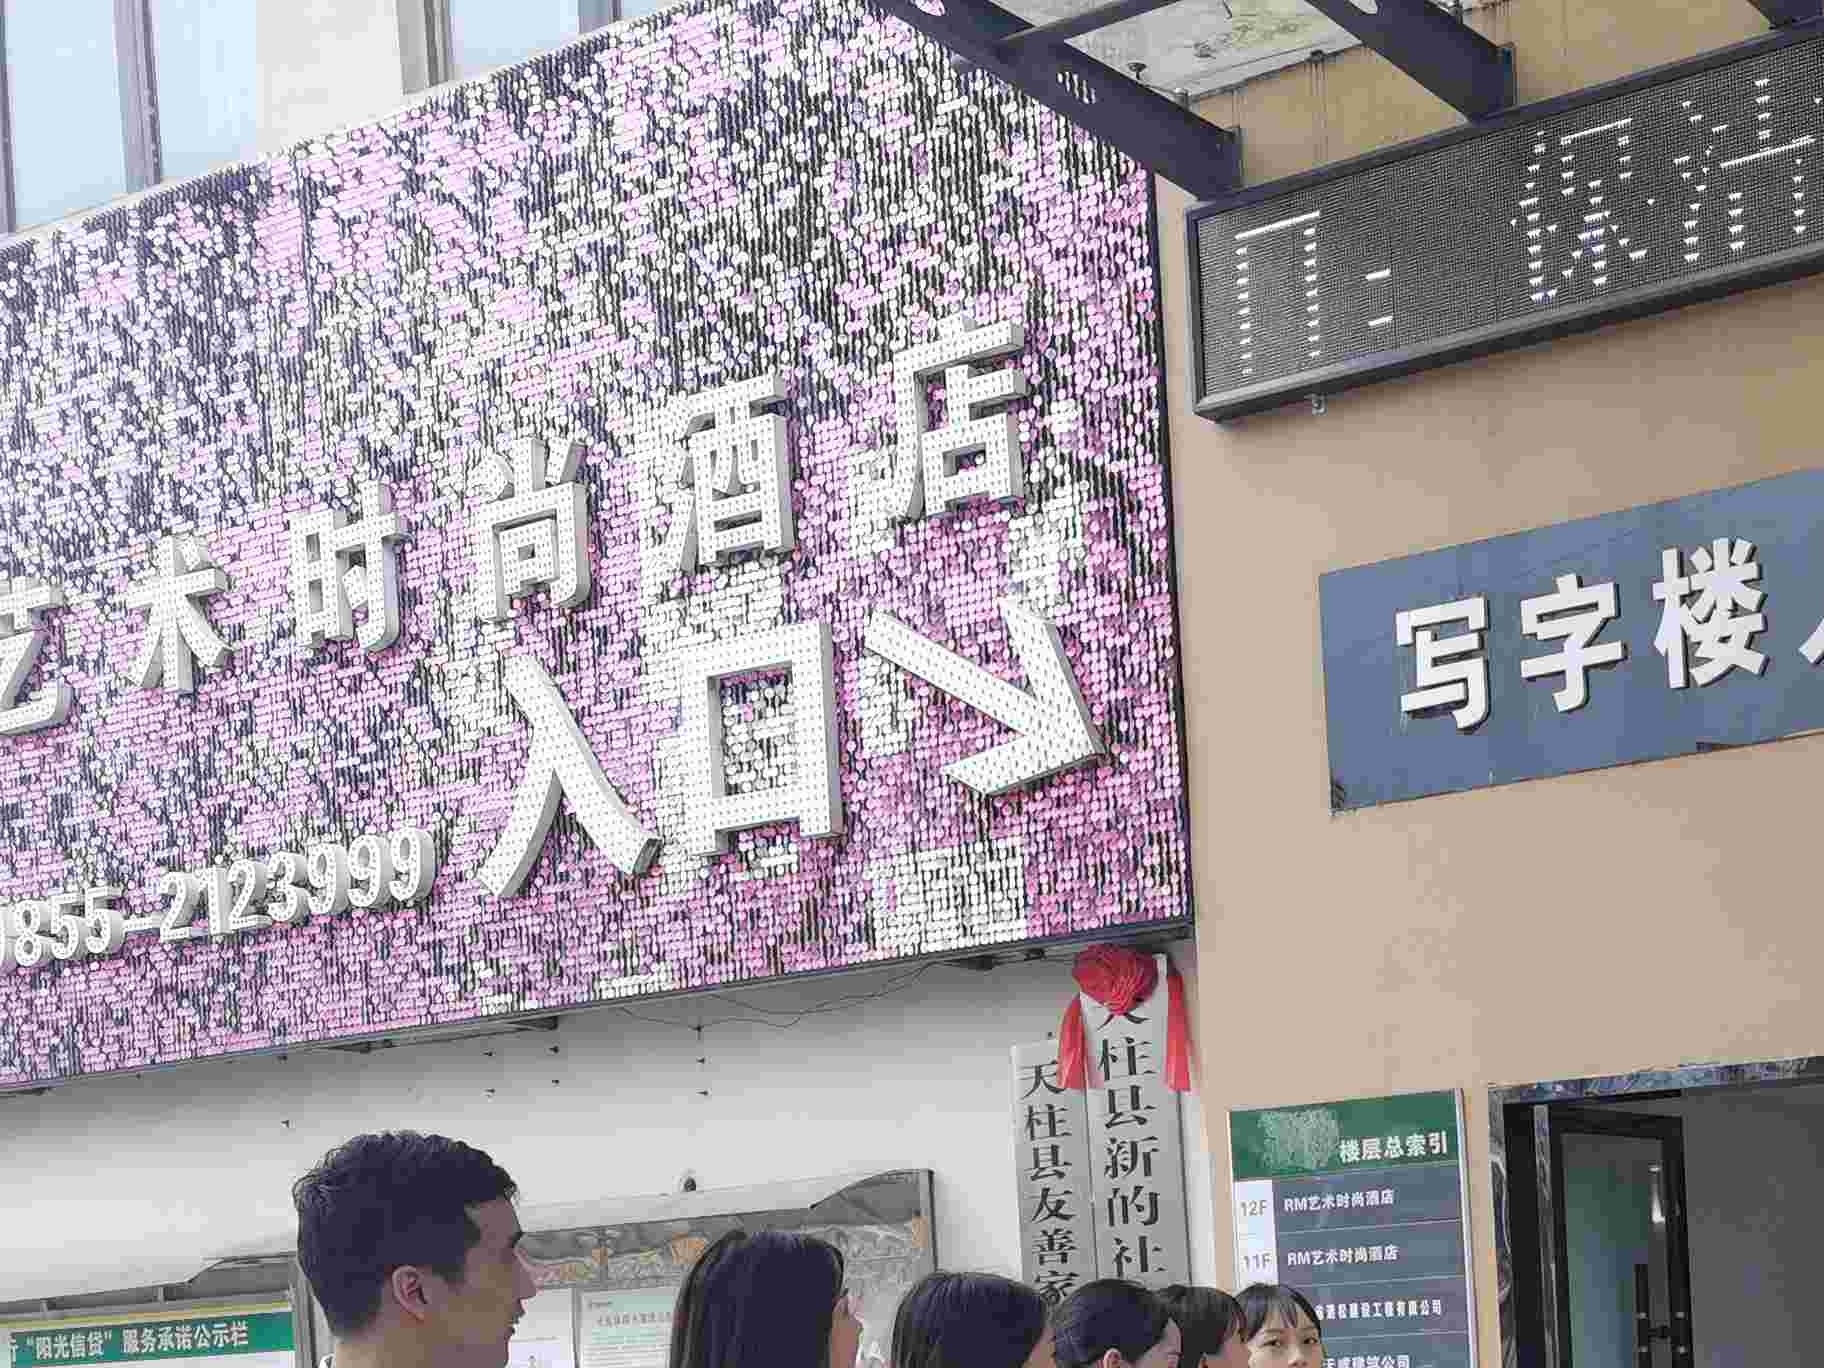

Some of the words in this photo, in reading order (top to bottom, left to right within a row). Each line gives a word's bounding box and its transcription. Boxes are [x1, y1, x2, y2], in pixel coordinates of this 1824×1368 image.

[0, 312, 1026, 736] 艺术时尚酒店
[478, 620, 846, 898] 入口
[0, 828, 436, 968] 855-2123999
[1338, 1131, 1448, 1163] 楼层总索引
[1240, 1200, 1268, 1217] 12F
[1283, 1188, 1396, 1213] RM艺术时尚酒店
[1242, 1253, 1273, 1273] 11F
[1286, 1244, 1400, 1267] RM艺术时尚酒店
[122, 1320, 249, 1354] 服务承诺公示栏
